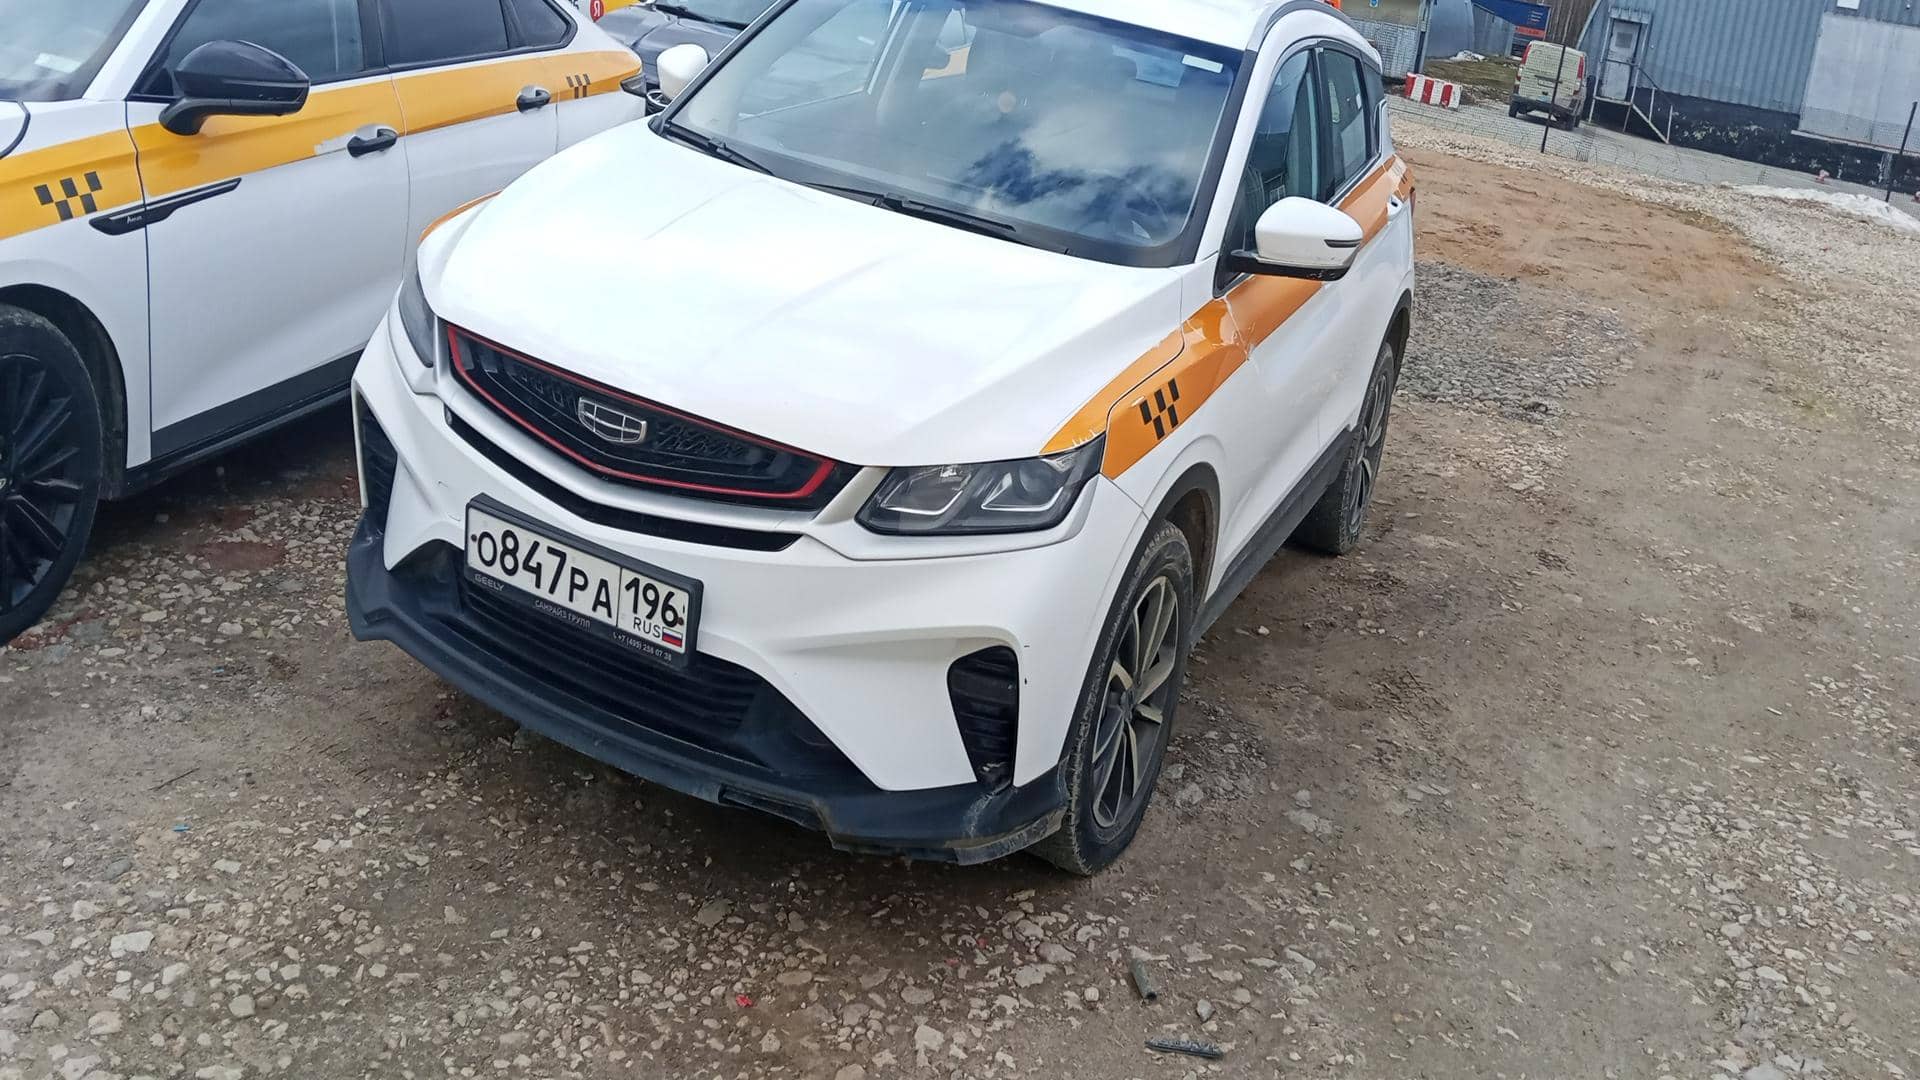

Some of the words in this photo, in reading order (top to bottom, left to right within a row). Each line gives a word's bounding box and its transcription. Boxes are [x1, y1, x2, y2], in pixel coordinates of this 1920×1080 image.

[474, 573, 505, 592] GEELY
[477, 529, 613, 619] О847РА
[625, 577, 679, 628] 196
[633, 616, 661, 639] RUS
